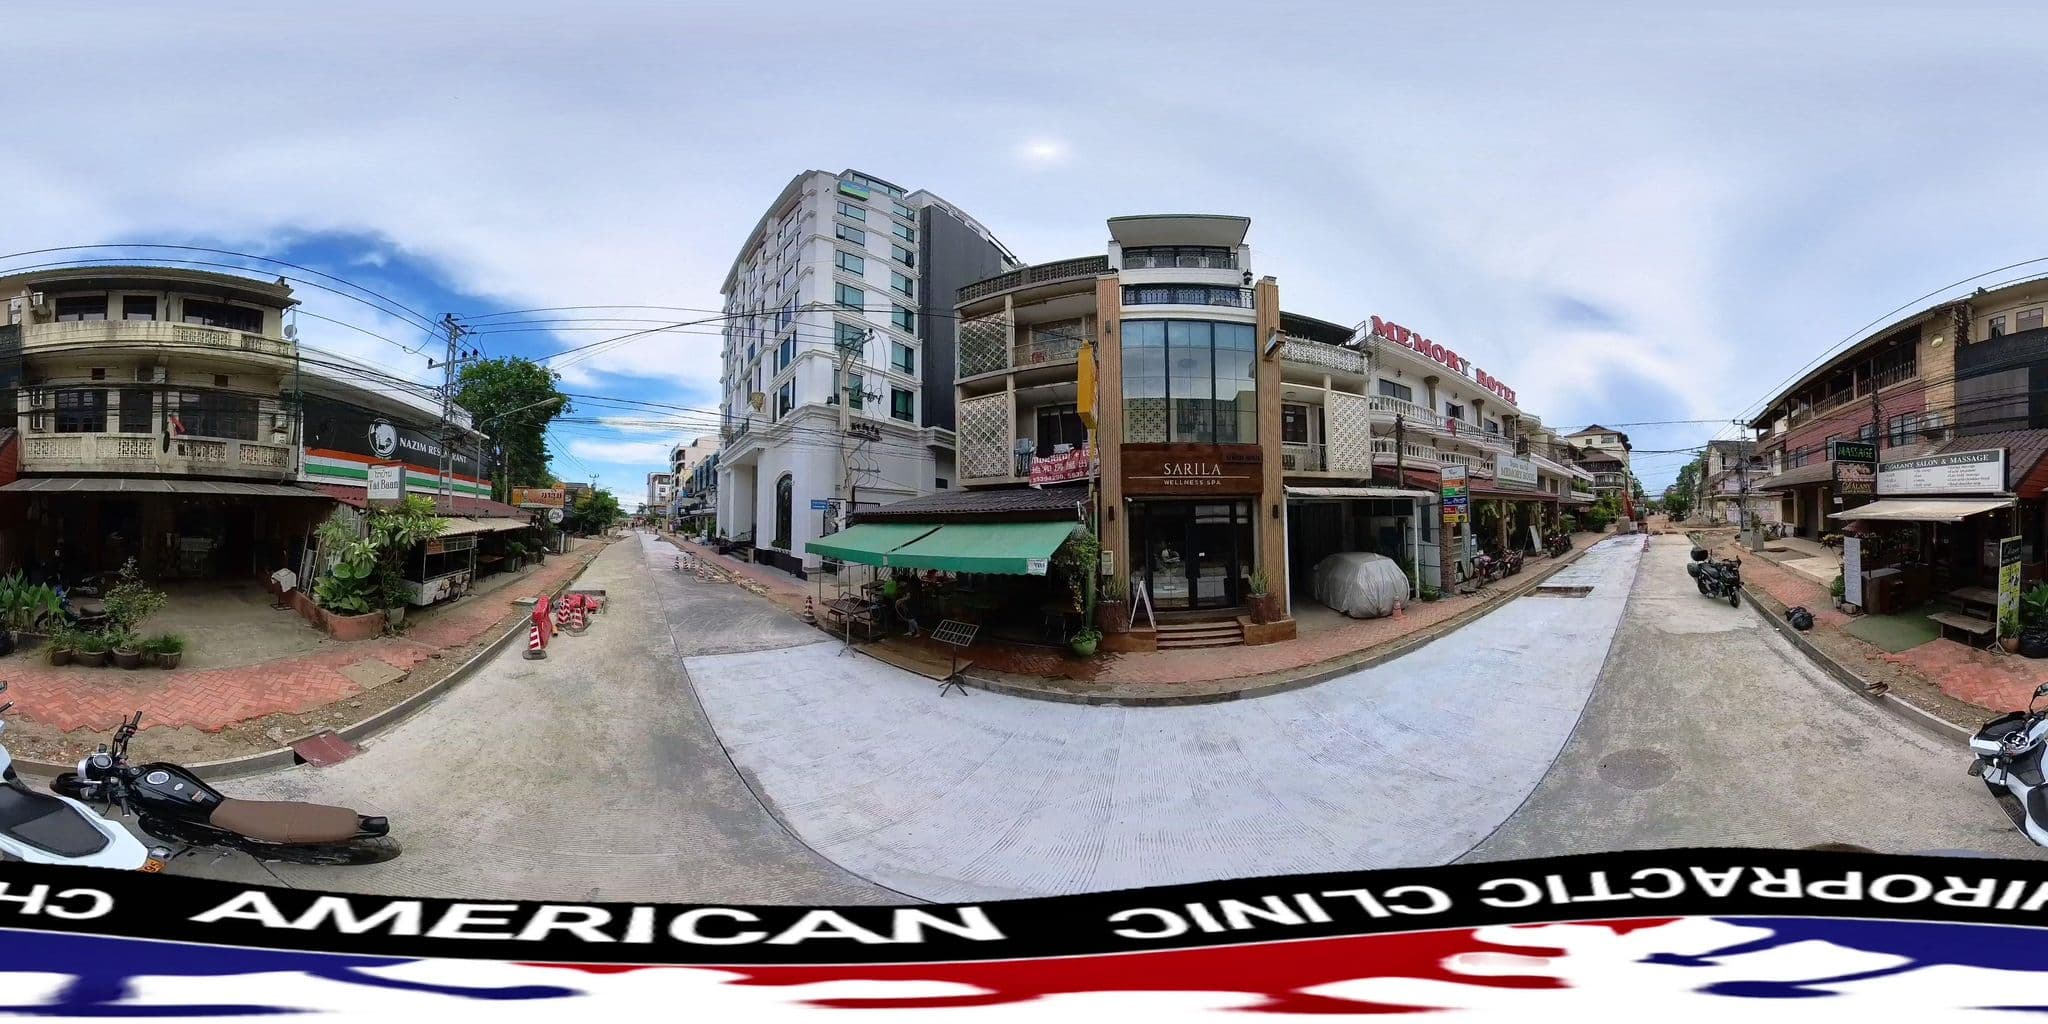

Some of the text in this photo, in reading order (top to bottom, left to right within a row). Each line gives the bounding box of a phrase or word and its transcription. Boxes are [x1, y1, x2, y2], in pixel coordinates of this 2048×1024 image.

[1371, 315, 1518, 406] MEMORY HOTEL
[400, 438, 426, 452] NAZIM
[1838, 446, 1873, 459] MASSAGE
[1916, 459, 1938, 467] SALON
[1950, 453, 1989, 463] MASSAGE
[1164, 462, 1221, 475] SARILA
[380, 479, 399, 490] Baan
